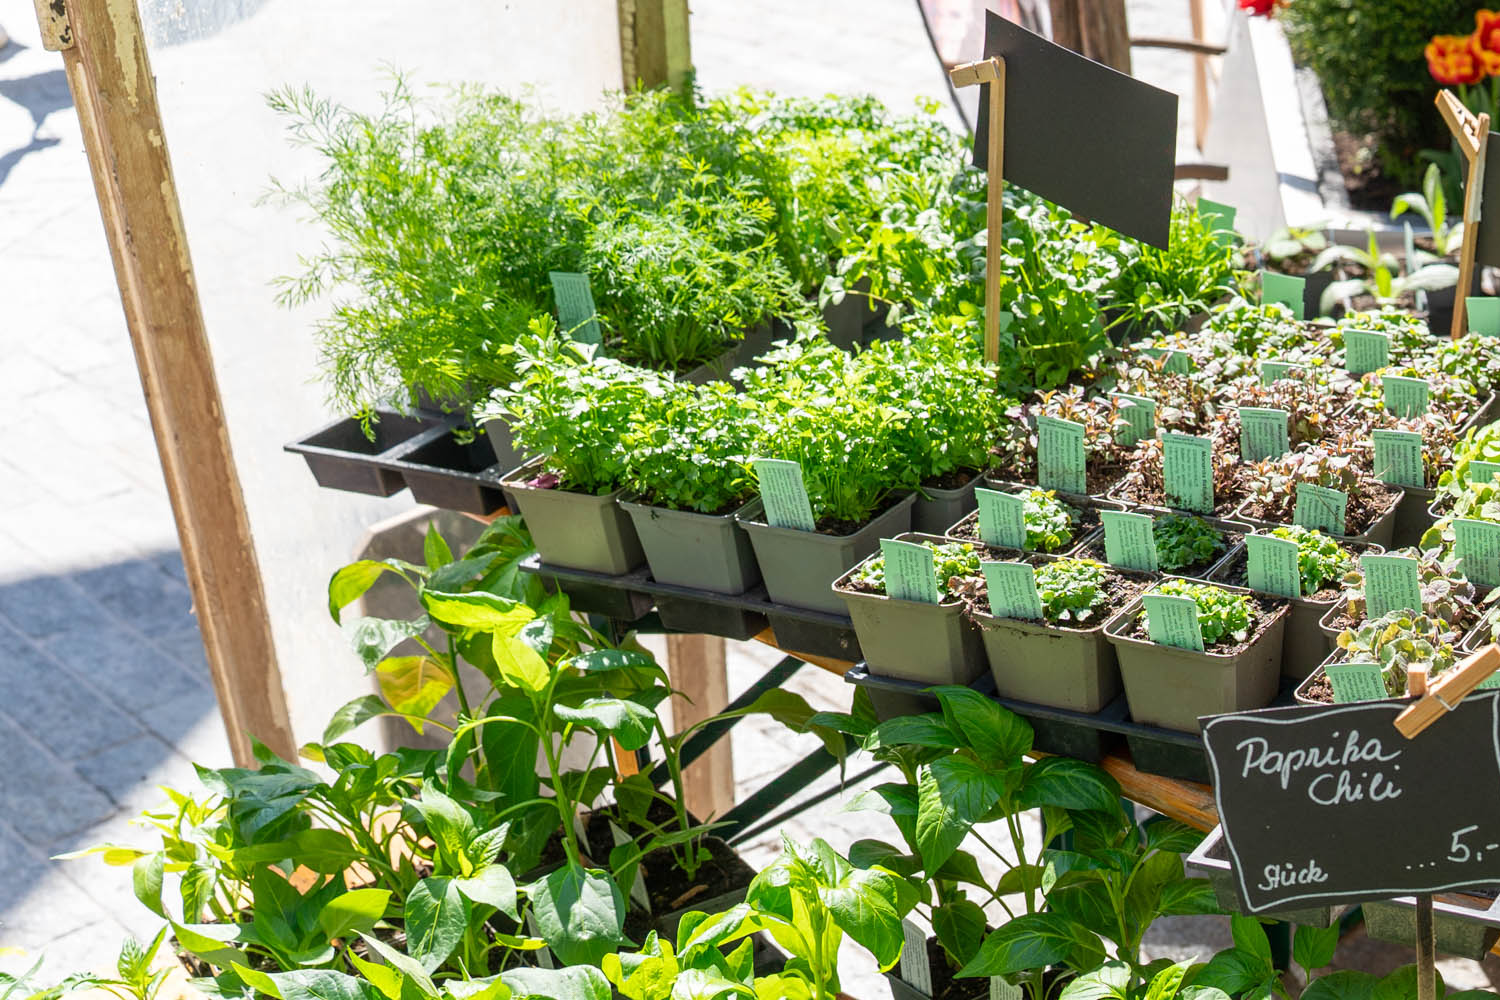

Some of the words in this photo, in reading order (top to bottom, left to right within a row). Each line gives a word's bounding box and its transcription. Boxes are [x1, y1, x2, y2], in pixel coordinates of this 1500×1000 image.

[1236, 730, 1402, 790] Paprika
[1308, 764, 1402, 805] Chili
[1258, 859, 1328, 891] Stück
